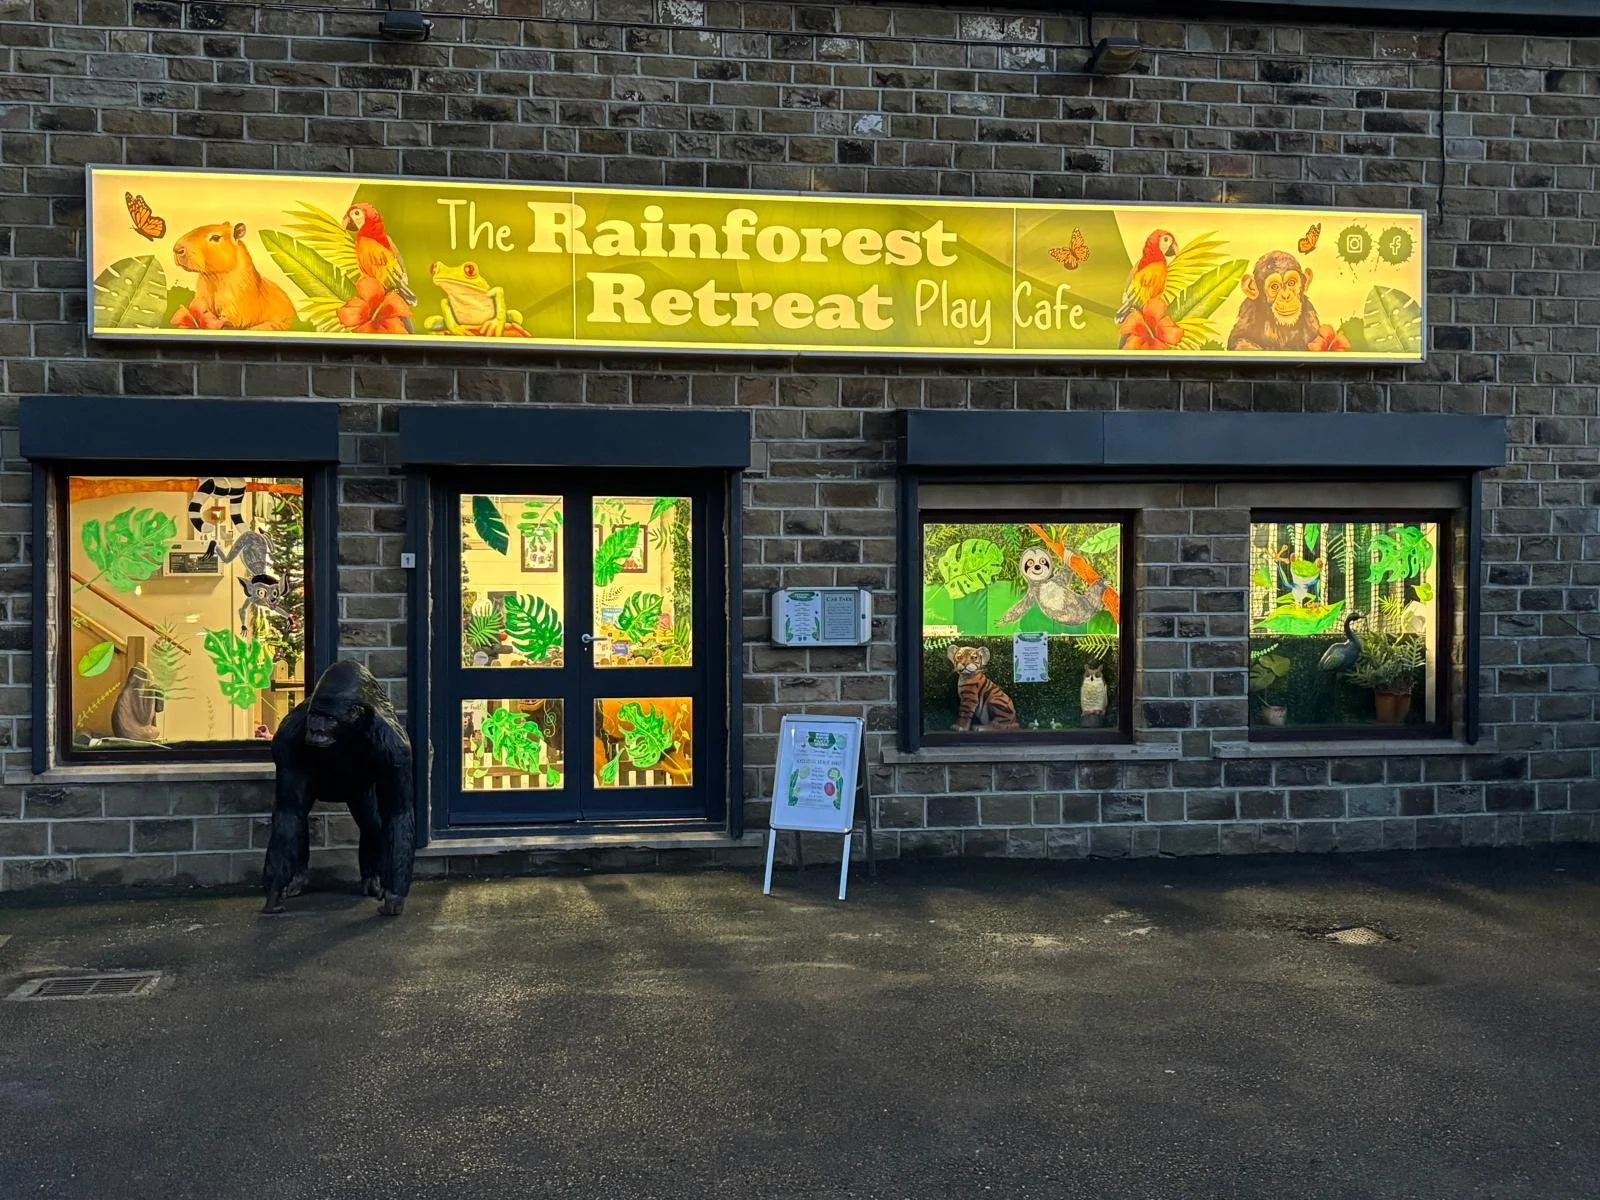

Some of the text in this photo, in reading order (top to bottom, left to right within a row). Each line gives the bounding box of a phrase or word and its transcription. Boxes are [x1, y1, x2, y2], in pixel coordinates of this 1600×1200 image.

[437, 198, 959, 267] The Rainforest
[586, 272, 1086, 346] Retreat Play Cafe
